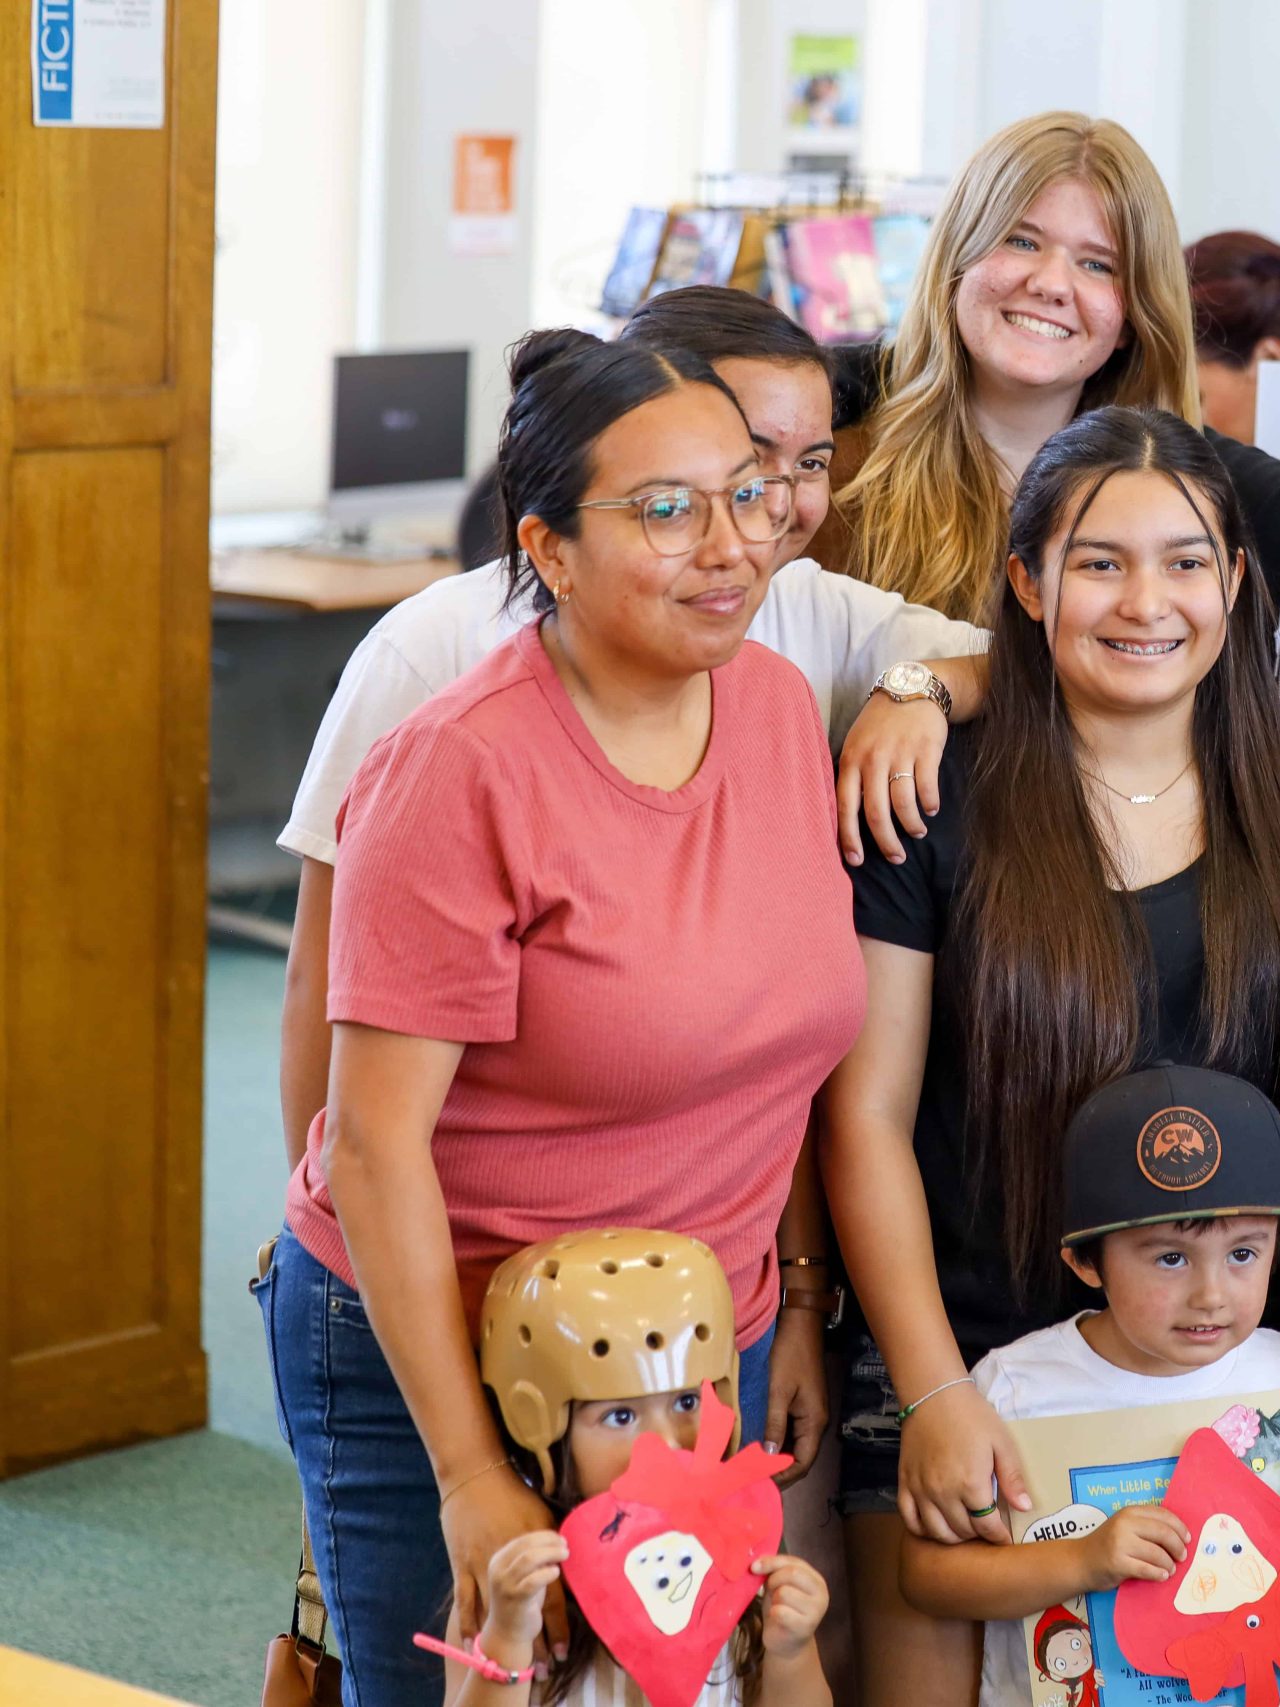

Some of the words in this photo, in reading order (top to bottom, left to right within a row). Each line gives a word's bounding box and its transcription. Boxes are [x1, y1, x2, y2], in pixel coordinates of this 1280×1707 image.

[1161, 1129, 1195, 1144] CW
[1087, 1484, 1117, 1497] When
[1120, 1479, 1151, 1493] Little
[1112, 1501, 1122, 1512] at
[1139, 1680, 1152, 1691] All
[1157, 1678, 1191, 1689] wolve
[1156, 1695, 1172, 1705] The
